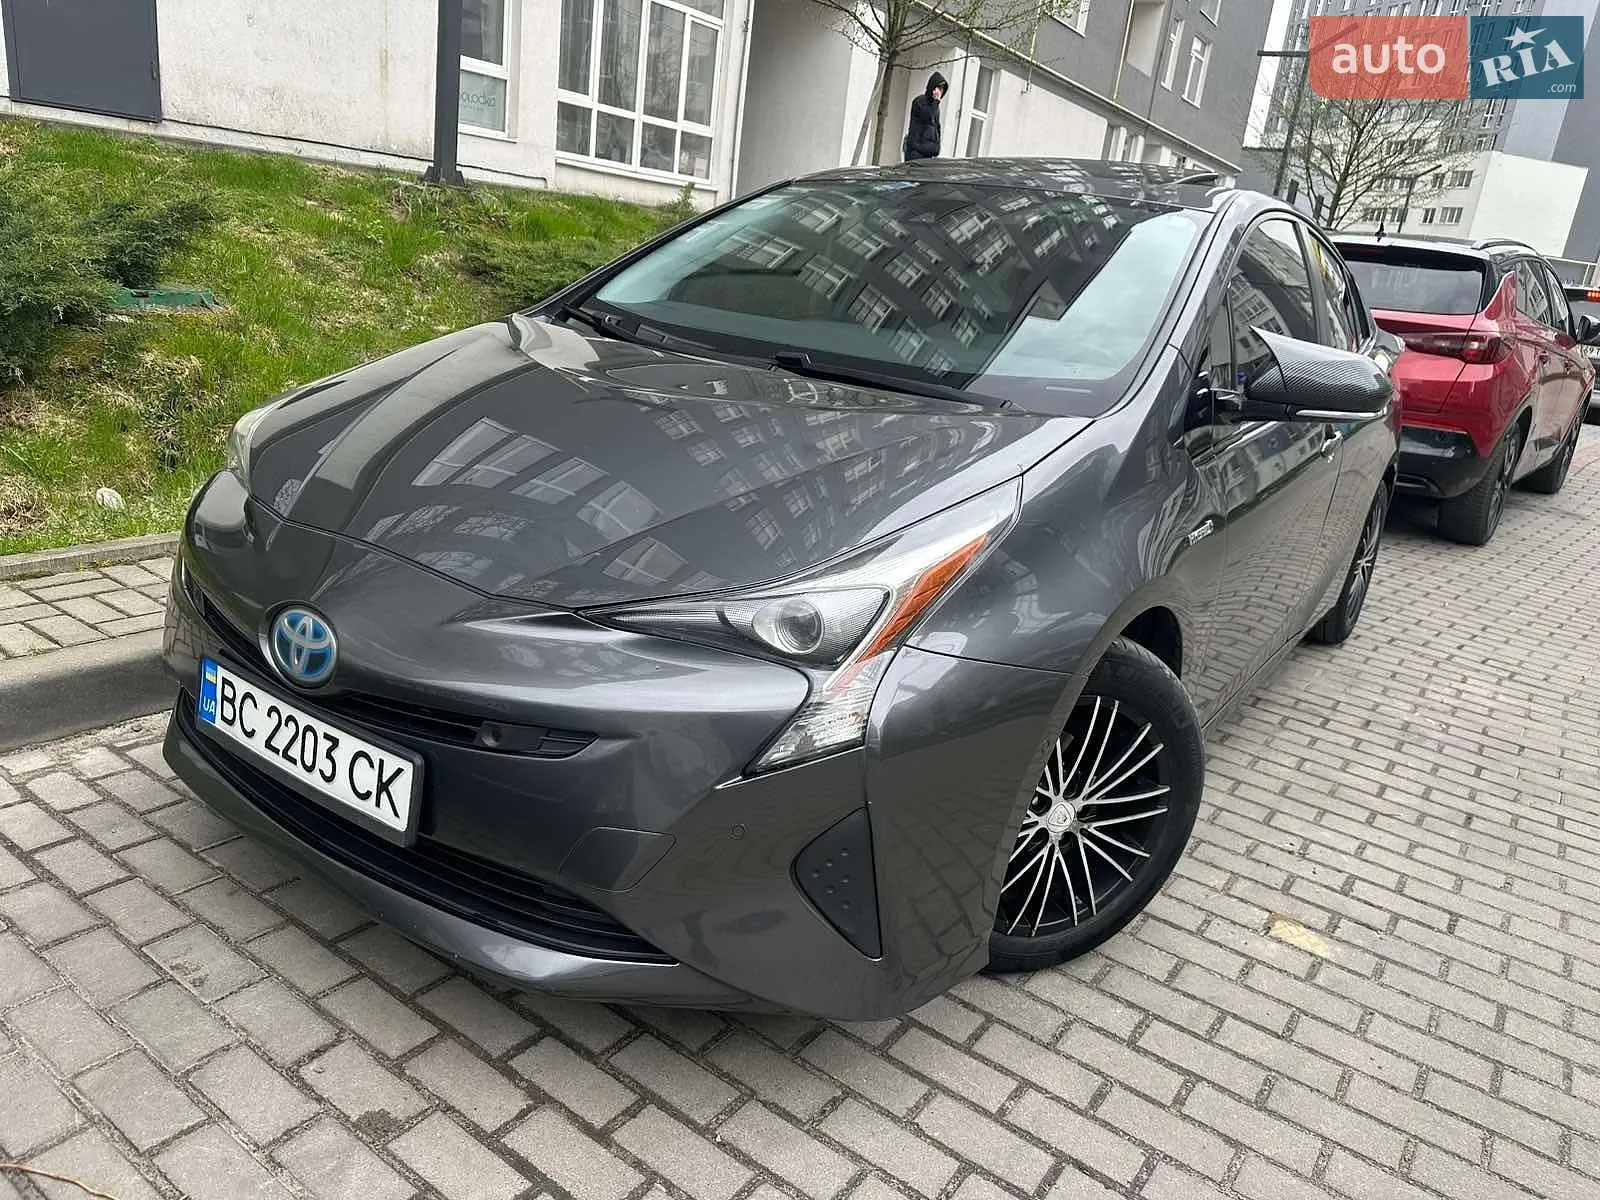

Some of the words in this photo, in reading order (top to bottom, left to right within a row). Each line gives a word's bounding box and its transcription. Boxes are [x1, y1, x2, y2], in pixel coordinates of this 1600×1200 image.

[202, 697, 216, 716] UA
[220, 677, 258, 739] BC
[264, 705, 340, 783] 2203
[349, 750, 405, 818] CK
